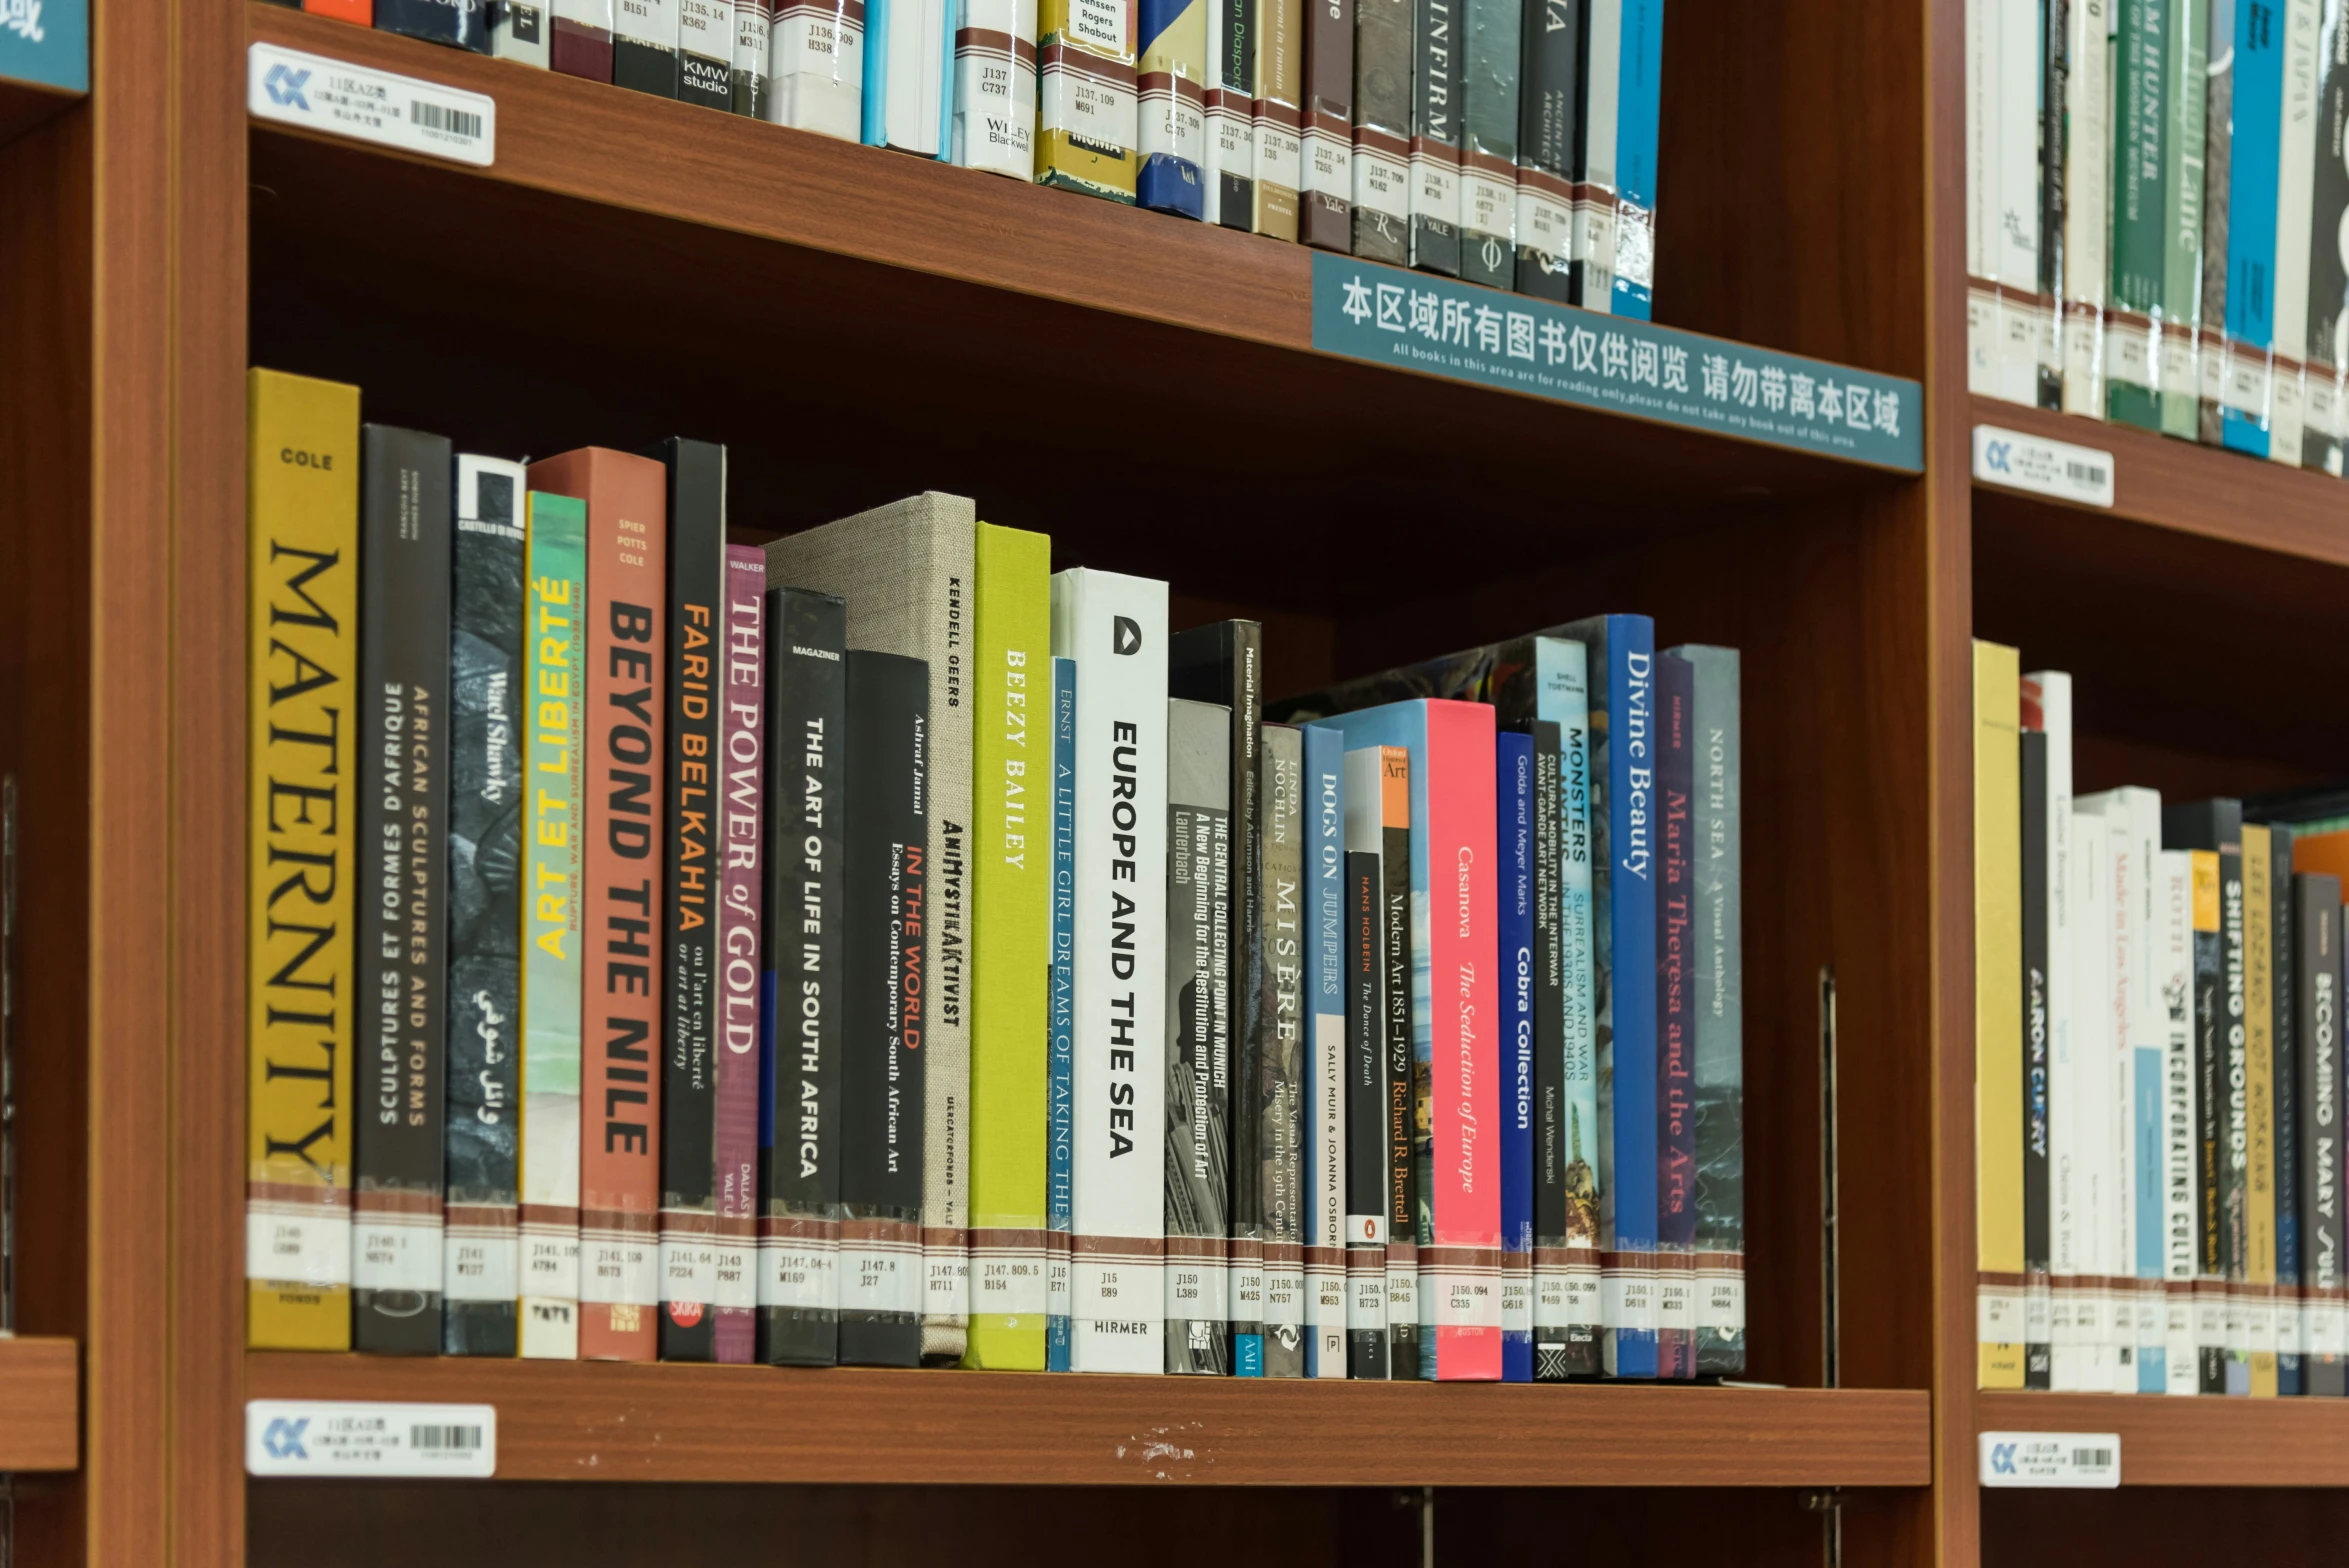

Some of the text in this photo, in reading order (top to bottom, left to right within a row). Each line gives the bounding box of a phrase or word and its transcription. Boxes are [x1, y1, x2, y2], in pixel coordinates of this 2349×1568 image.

[682, 15, 707, 30] R362
[1078, 23, 1117, 43] Shabout
[1082, 10, 1113, 26] Rogers
[684, 60, 728, 82] KMW
[809, 39, 833, 54] H338
[684, 75, 728, 95] studio
[982, 68, 1007, 80] J137
[982, 82, 1007, 95] C737
[1075, 86, 1115, 106] J137.109
[2142, 49, 2161, 180] HUNTER
[990, 132, 1028, 152] Blackwell
[1315, 147, 1345, 165] J137.34
[1268, 203, 1292, 216] PRESTEL
[1324, 197, 1343, 213] Yale
[1427, 219, 1448, 236] YALE
[1342, 276, 1901, 438] 本区域所有图书仅供阅览 请勿带离本区域
[1393, 343, 1409, 357] All
[1412, 346, 1446, 364] books
[1450, 353, 1460, 367] in
[1464, 358, 1486, 373] this
[1489, 364, 1514, 378] area
[1517, 370, 1535, 383] are
[1538, 372, 1553, 386] for
[1557, 378, 1598, 398] reading
[1666, 400, 1679, 412] do
[1682, 405, 1700, 416] not
[1703, 407, 1725, 421] take
[1728, 414, 1747, 429] any
[1750, 417, 1774, 432] book
[281, 448, 332, 470] COLE
[618, 536, 647, 550] POTTS
[619, 520, 646, 533] SPIER
[619, 553, 644, 566] COLE
[730, 560, 764, 572] WALKER
[792, 646, 840, 660] MAGAZINER
[948, 578, 960, 707] KENDELL GEERS
[1245, 647, 1255, 758] Material Imagination
[481, 672, 508, 804] Wael Shawky
[914, 714, 925, 815] Ashraf Jamal
[1005, 649, 1026, 871] BEEZY BAILEY
[532, 576, 570, 960] ART ET LIBERTÉ
[680, 604, 709, 931] FARID BELKAHIA
[1289, 762, 1297, 817] LINDA
[1384, 763, 1406, 778] Art
[1624, 652, 1651, 880] Divine Beauty
[1274, 759, 1285, 843] NOCHLIN
[1710, 729, 1724, 859] NORTH SEA
[725, 597, 760, 1054] THE POWER of GOLD
[1176, 812, 1190, 885] Lauterbach
[265, 538, 340, 1186] MATERNITY
[606, 601, 652, 1155] BEYOND THE NILE
[1322, 774, 1339, 995] DOGS ON JUMPERS
[381, 683, 403, 1124] SCULPTURES ET FORMES D'AFRIQUE
[409, 686, 429, 1126] AFRICAN SCULPTURES AND FORMS
[800, 718, 824, 1178] THE ART OF LIFE IN SOUTH AFRICA
[904, 846, 922, 1049] IN THE WORLD
[1055, 689, 1072, 1212] ERNST A LITTLE GIRL DREAMS OF TAKING THE
[1110, 721, 1137, 1158] EUROPE AND THE SEA
[1214, 817, 1227, 1088] THE CENTRAL COLLECTING POINT IN MUNICH
[1362, 918, 1370, 972] HOLBEIN
[887, 843, 903, 1173] Essays on Contemporary South African Art
[1458, 847, 1476, 1193] Casanova The Seduction of Europe
[1668, 789, 1689, 1214] Maria Theresa and the Arts
[2226, 880, 2247, 1170] SHIFTING GROUNDS
[1391, 894, 1408, 1223] Modern Art 1851–1929 Richard R. Brettell
[2315, 972, 2335, 1218] BECOMING MARY
[861, 1260, 895, 1272] J147.8
[861, 1275, 878, 1286] J27
[985, 1264, 1039, 1276] J147.809.5
[985, 1279, 1006, 1291] B154
[1102, 1273, 1117, 1283] J15
[1102, 1287, 1117, 1297] E89
[1177, 1274, 1198, 1284] J150
[1177, 1288, 1198, 1298] L389
[1241, 1276, 1260, 1287] J150
[1451, 1285, 1488, 1295] J150.094
[1094, 1321, 1147, 1334] HIRMER
